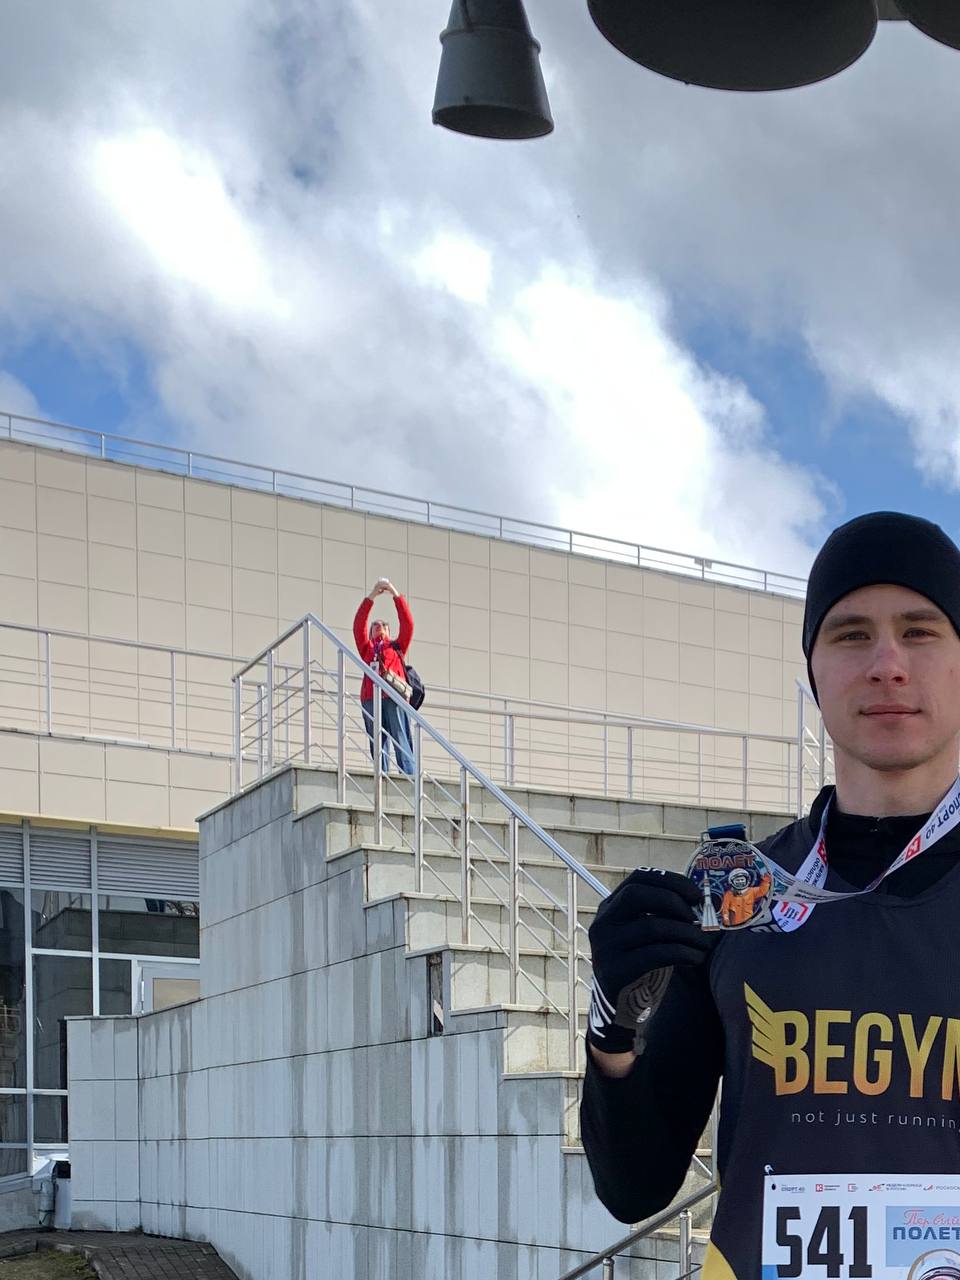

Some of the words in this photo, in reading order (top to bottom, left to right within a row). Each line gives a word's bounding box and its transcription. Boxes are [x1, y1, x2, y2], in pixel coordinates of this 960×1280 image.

[925, 825, 936, 840] 40
[696, 854, 757, 870] ПОЛЕТ
[791, 1110, 825, 1125] not
[833, 1109, 878, 1127] just
[776, 1205, 873, 1279] 541
